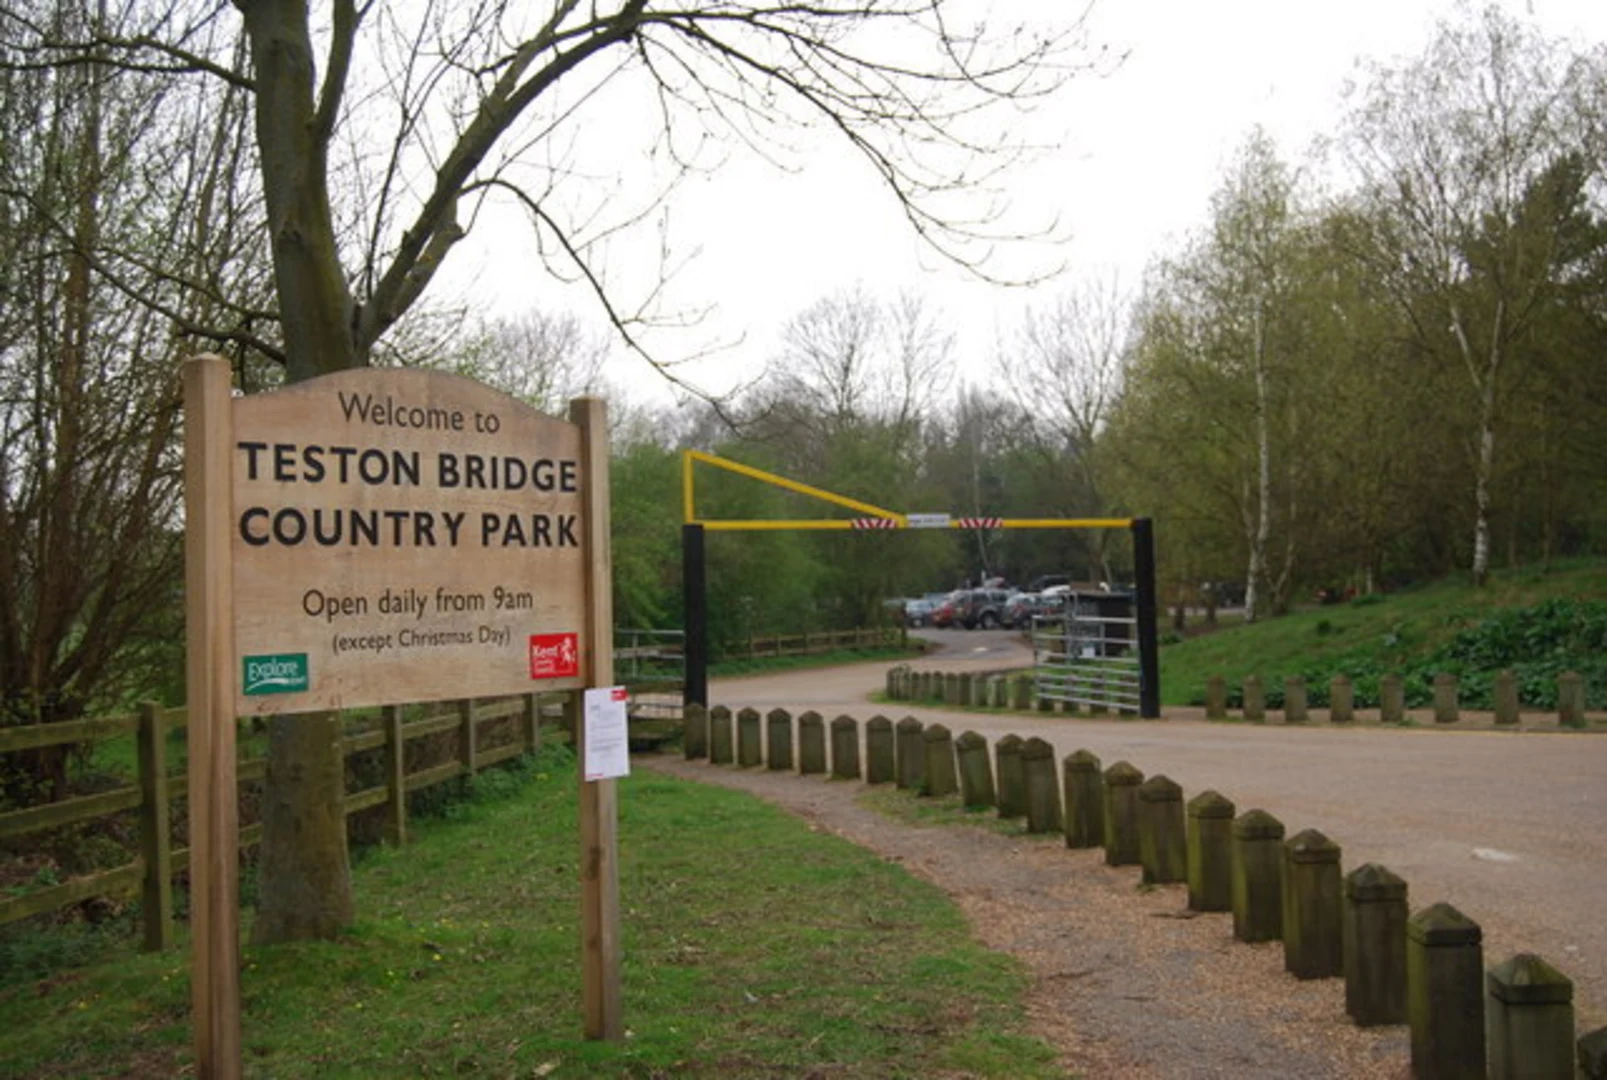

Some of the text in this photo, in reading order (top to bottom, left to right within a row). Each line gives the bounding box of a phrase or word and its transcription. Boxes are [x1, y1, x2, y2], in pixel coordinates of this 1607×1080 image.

[338, 391, 500, 433] Welcome to
[238, 441, 577, 492] TESTON BRIDGE
[239, 507, 579, 548] COUNTRY PARK
[303, 586, 534, 622] Open daily from 9am
[332, 625, 511, 654] (except Christmas Day)
